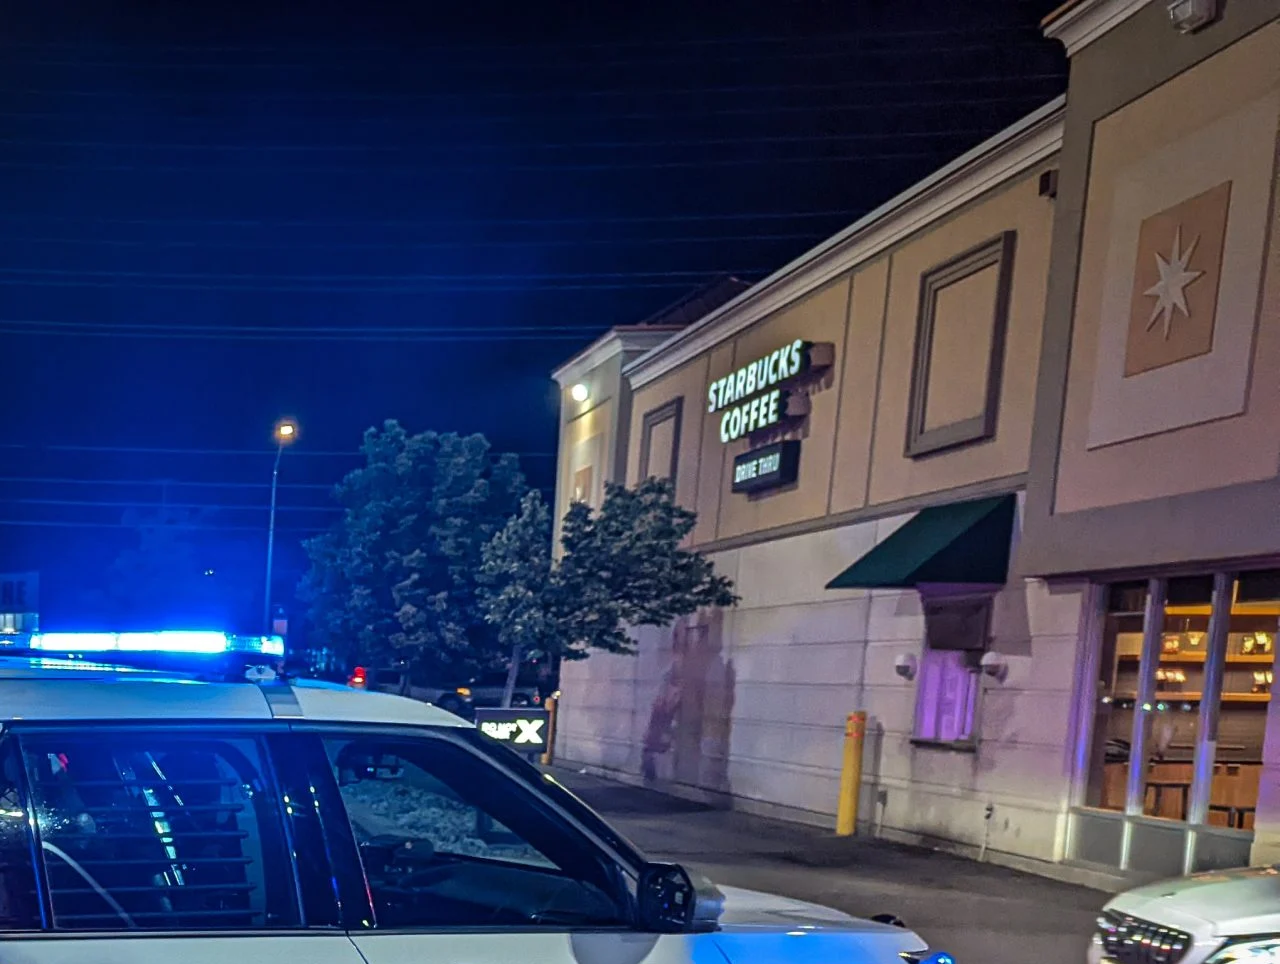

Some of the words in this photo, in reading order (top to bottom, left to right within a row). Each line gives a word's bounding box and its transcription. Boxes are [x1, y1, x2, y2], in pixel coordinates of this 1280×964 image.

[708, 338, 803, 413] STARBUCKS
[720, 389, 780, 443] COFFEE
[734, 459, 757, 482] DRIVE
[758, 453, 780, 475] THRU
